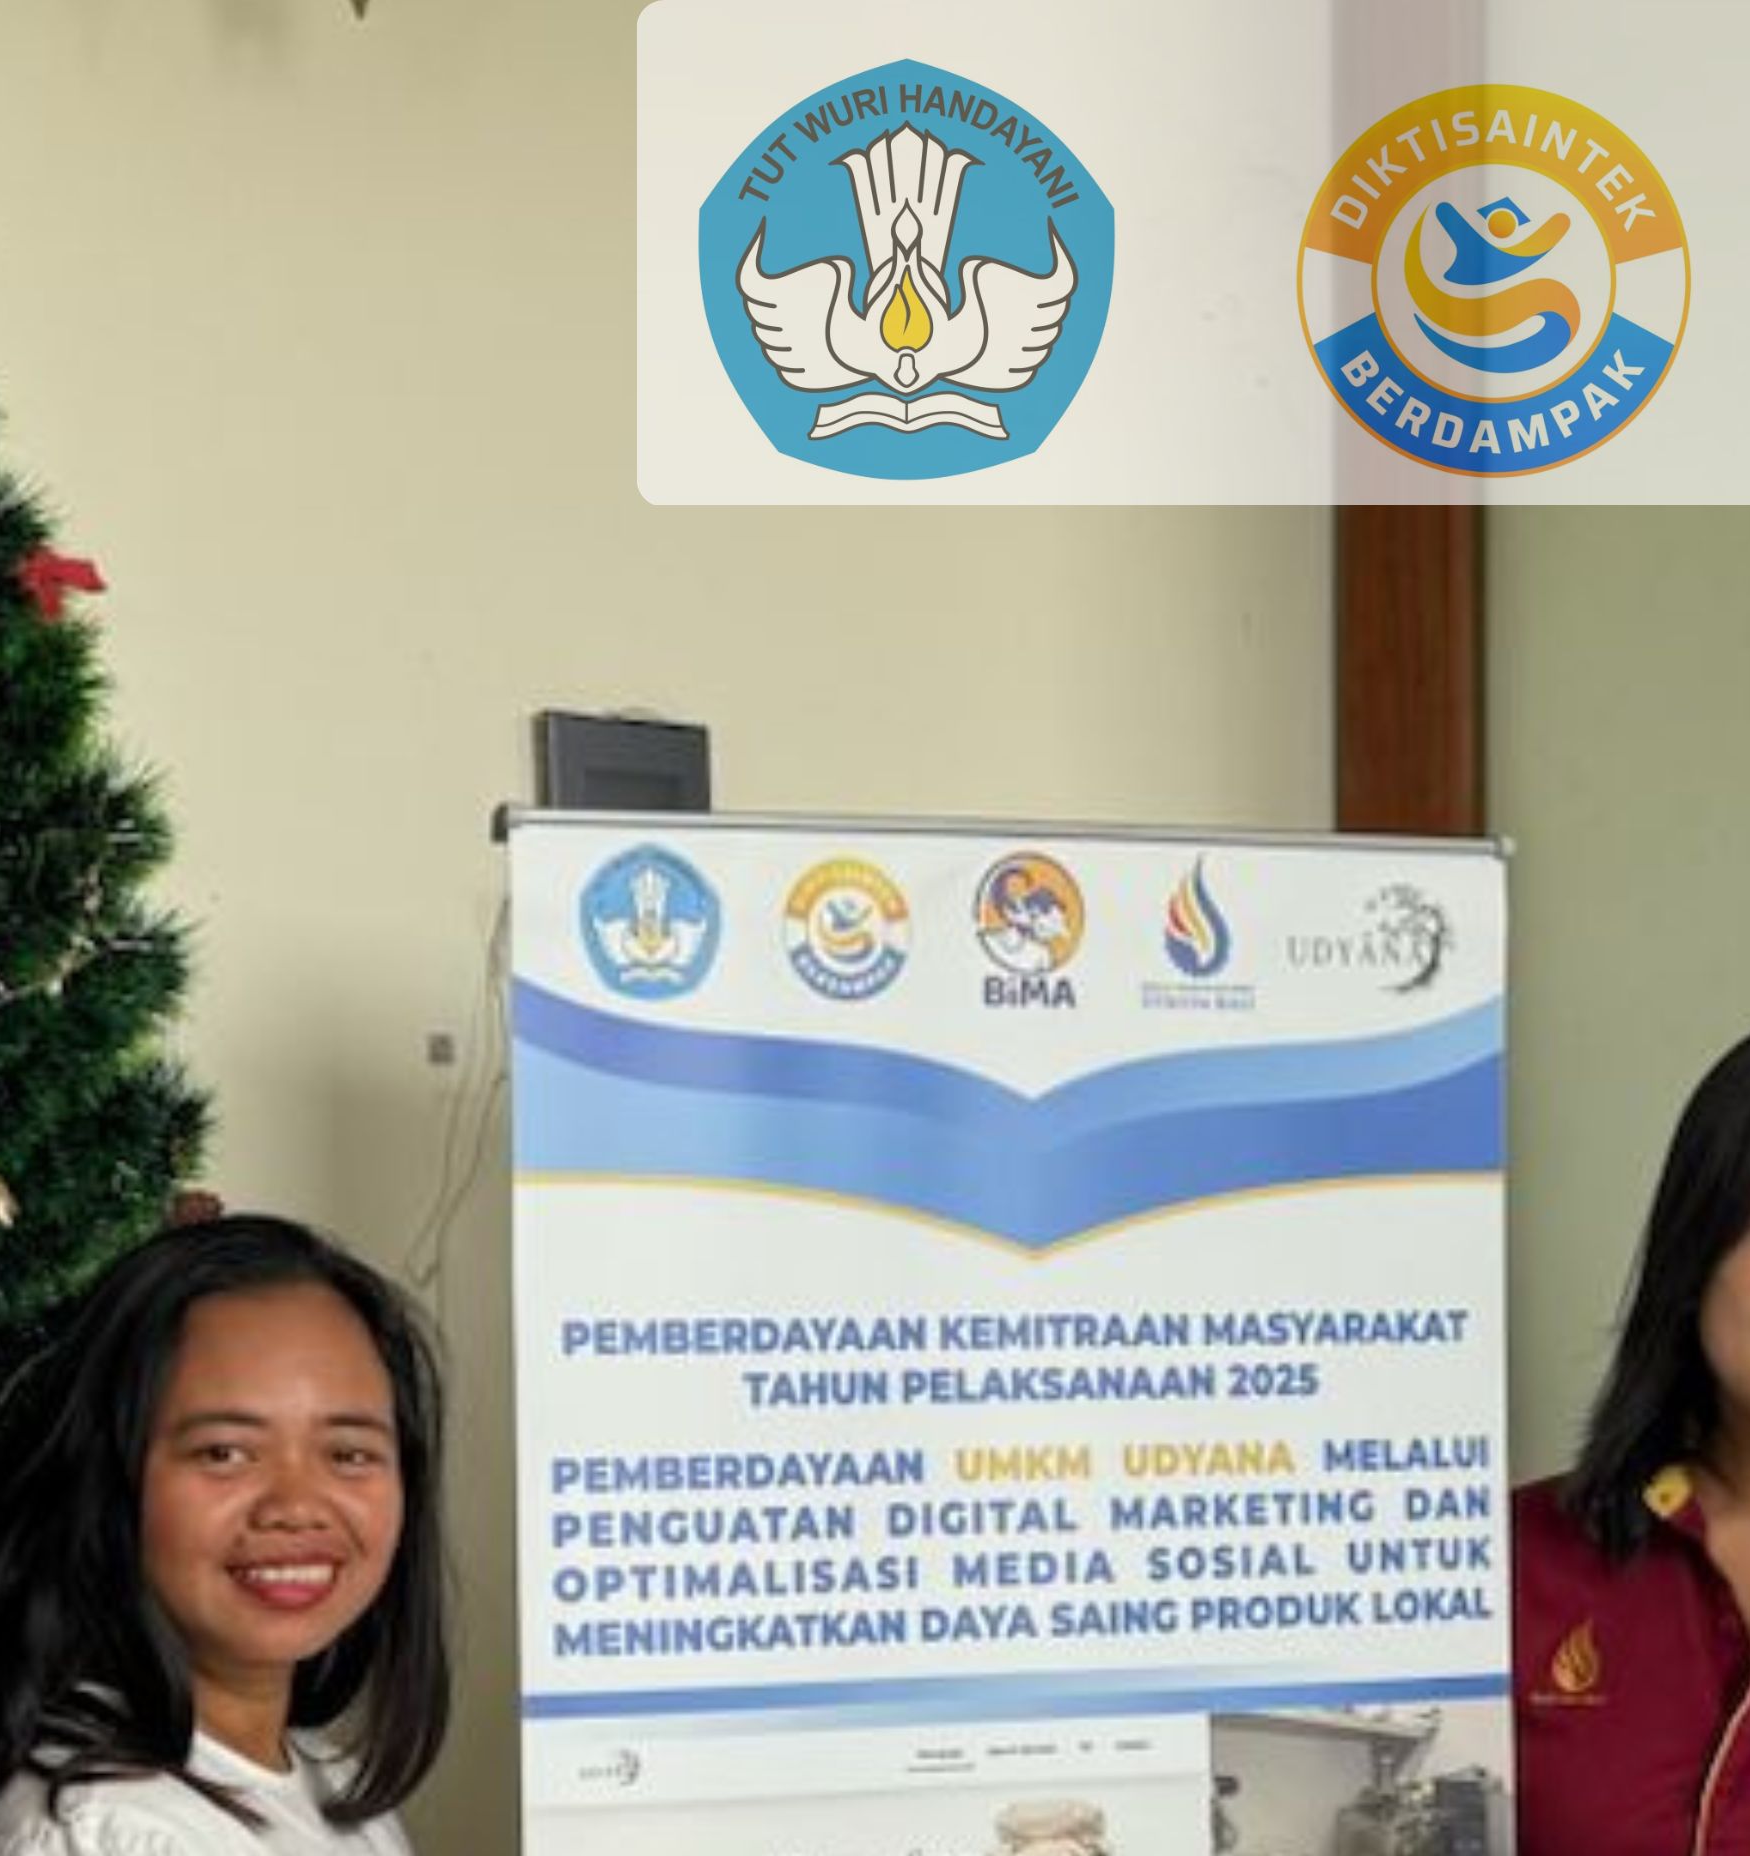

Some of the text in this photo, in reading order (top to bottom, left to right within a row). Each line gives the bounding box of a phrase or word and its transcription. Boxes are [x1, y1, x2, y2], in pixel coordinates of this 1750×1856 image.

[562, 1309, 1468, 1355] PEMBERDAYAAN KEMITRAAN MASYARAKAT
[742, 1362, 1320, 1407] TAHUN PELAKSANAAN 2025
[552, 1436, 1490, 1493] PEMBERDAYAAN UMKM UDYANA MELALUI
[552, 1486, 1491, 1548] PENGUATAN DIGITAL MARKETING DAN
[552, 1538, 1492, 1602] OPTIMALISASI MEDIA SOSIAL UNTUK
[553, 1587, 1495, 1657] MENINGKATKAN DAYA SAING PRODUK LOKAL
